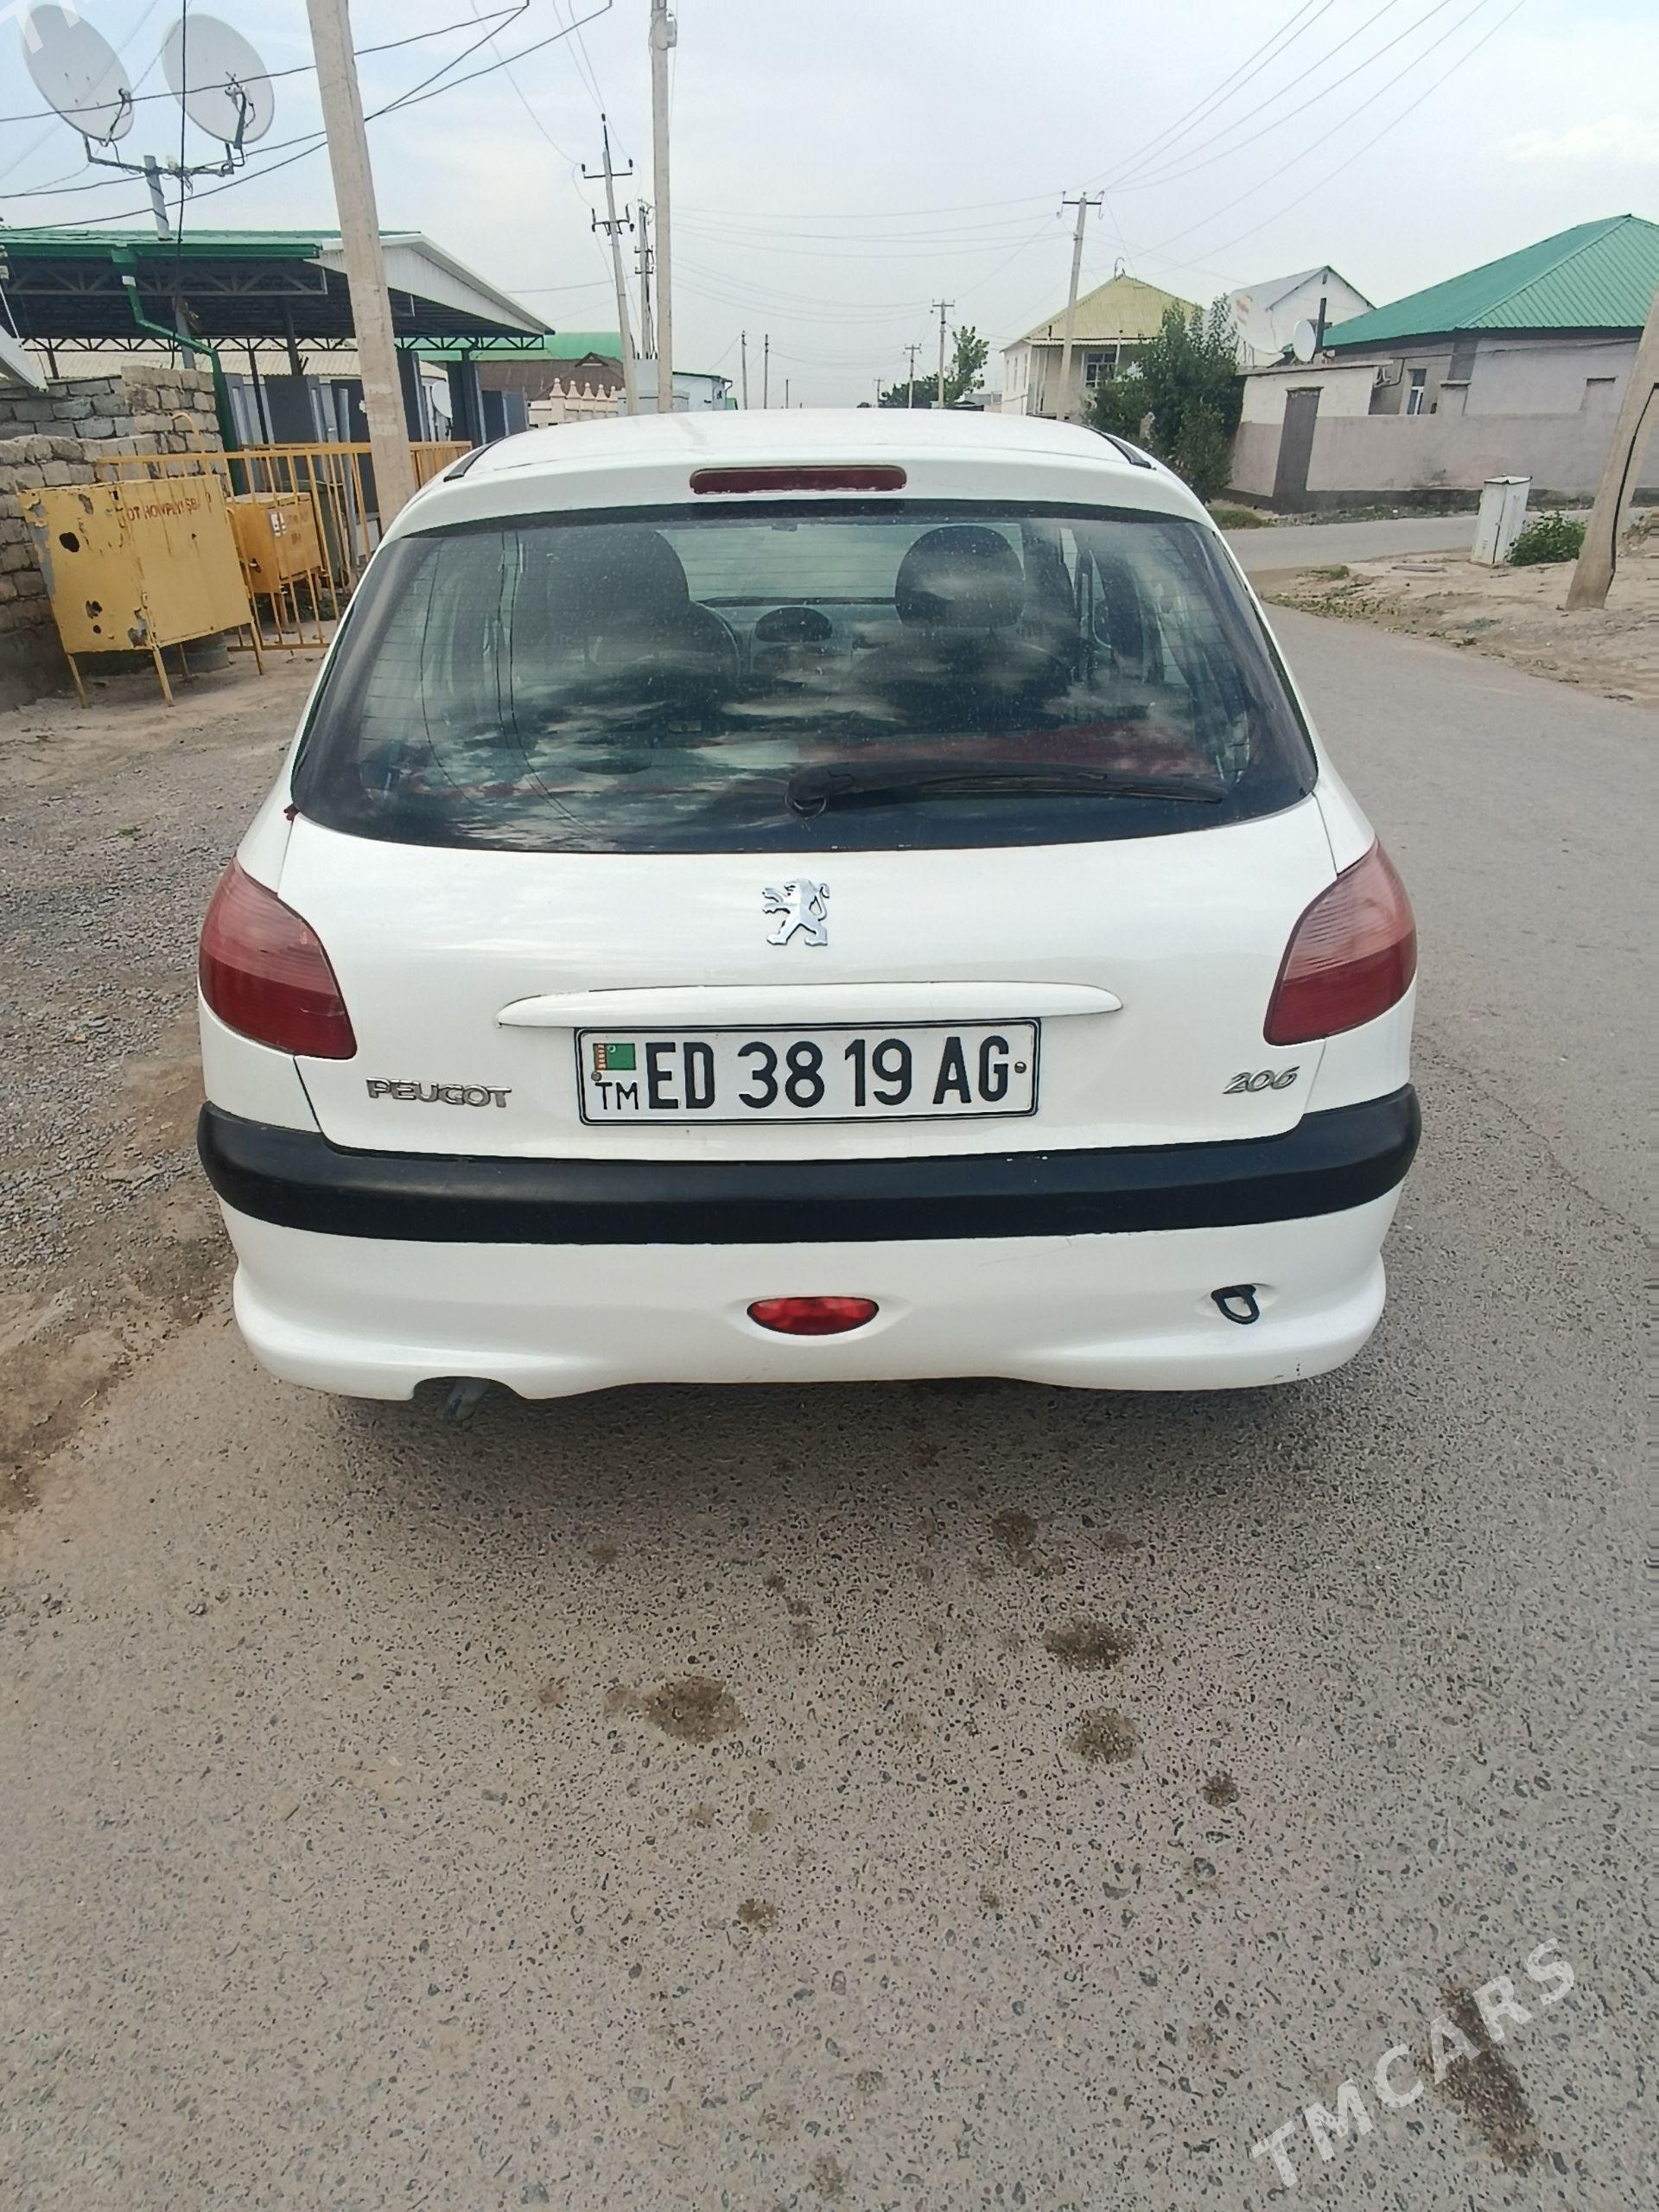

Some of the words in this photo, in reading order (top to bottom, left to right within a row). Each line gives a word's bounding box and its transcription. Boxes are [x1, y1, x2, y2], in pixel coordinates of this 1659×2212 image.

[645, 1042, 715, 1109] ED
[738, 1041, 825, 1109] 38
[844, 1038, 912, 1108] 19
[932, 1035, 1010, 1104] AG
[1222, 1065, 1300, 1094] 206
[366, 1077, 512, 1108] PEUGOT
[595, 1082, 639, 1110] TM
